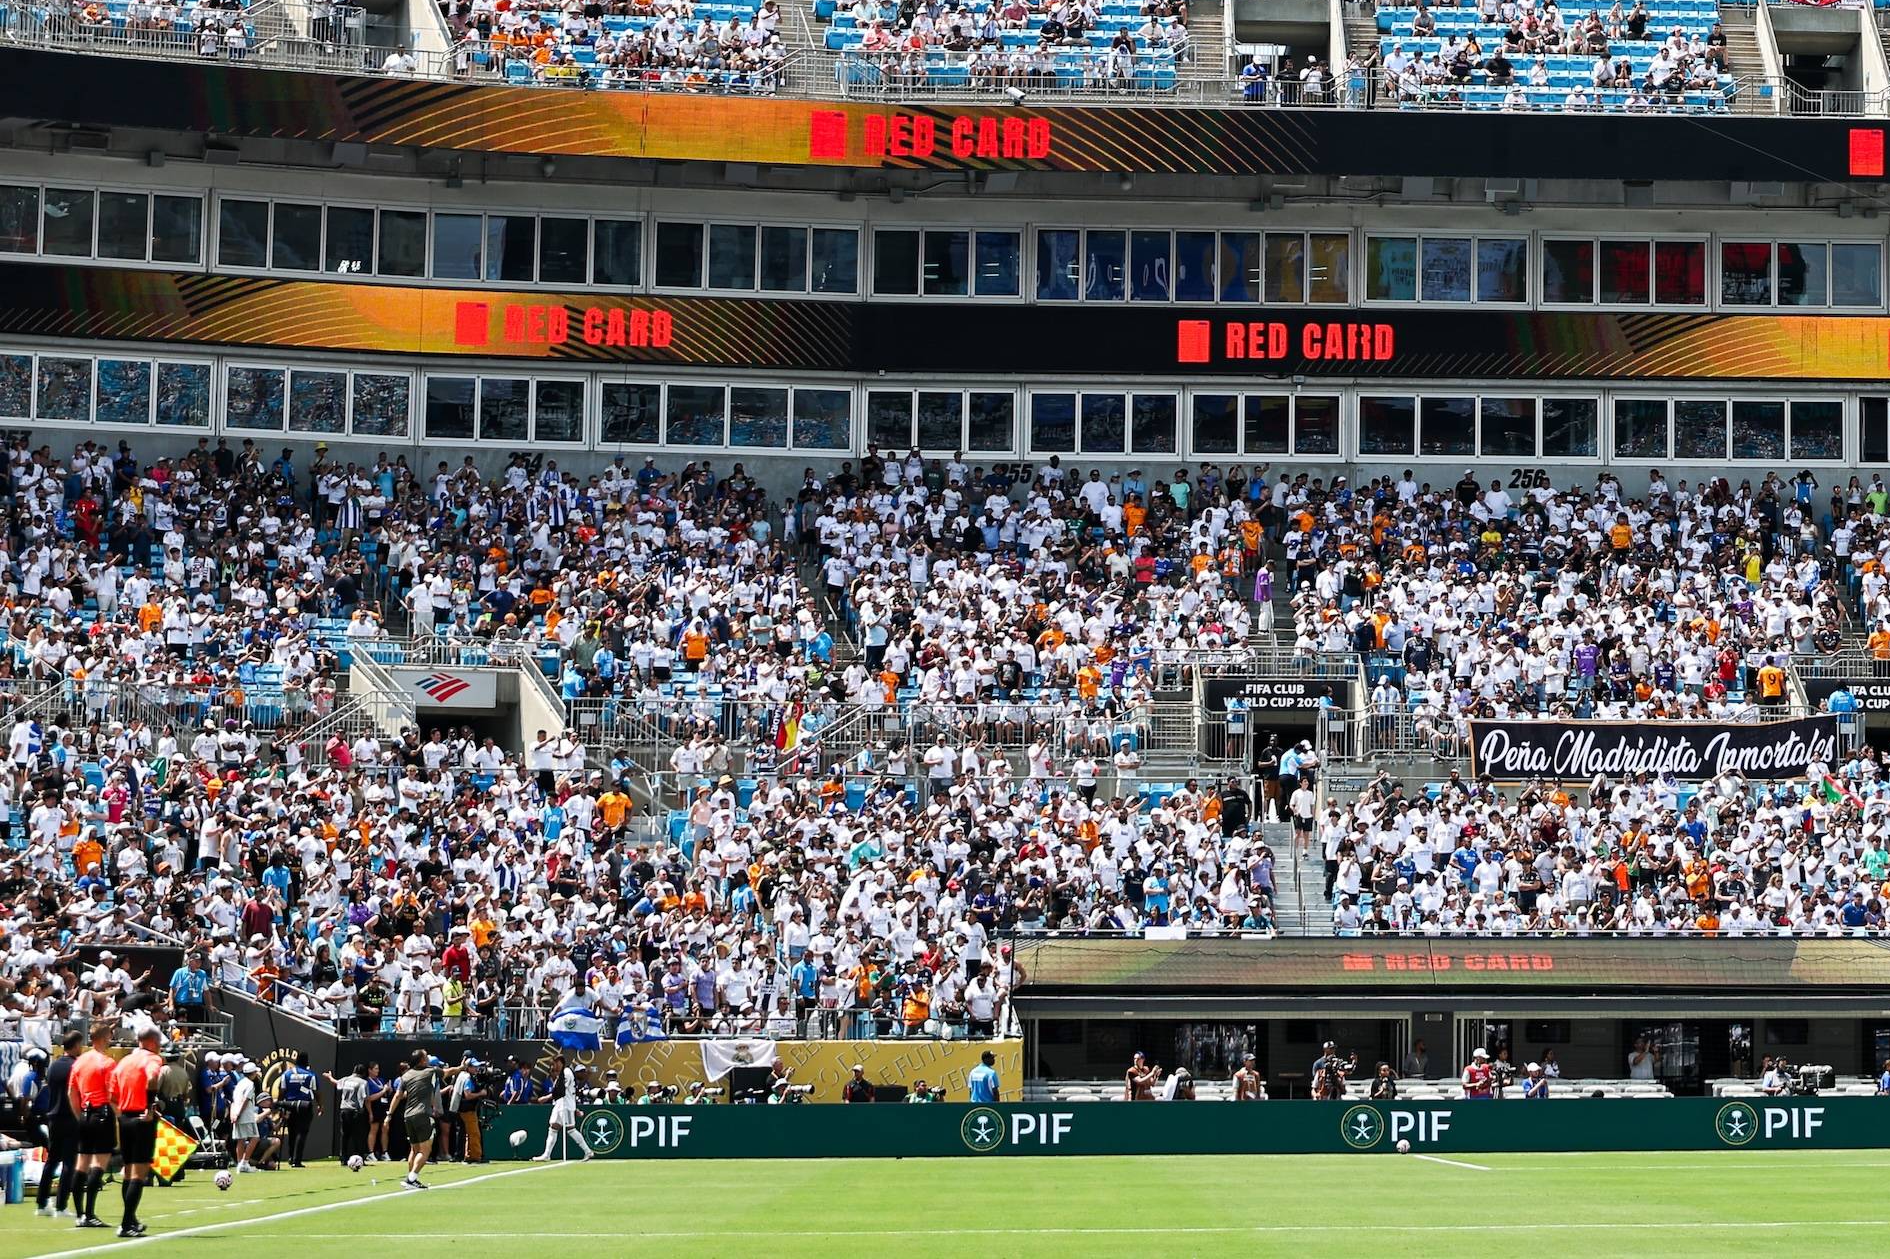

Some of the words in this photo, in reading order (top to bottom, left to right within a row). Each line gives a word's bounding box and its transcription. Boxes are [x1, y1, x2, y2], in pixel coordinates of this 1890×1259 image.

[864, 113, 935, 158] RED
[952, 116, 1051, 158] CARD
[504, 304, 569, 344] RED
[583, 307, 673, 348] CARD
[1226, 322, 1288, 359] RED
[1303, 323, 1393, 360] CARD
[1008, 463, 1033, 484] 55
[1508, 468, 1546, 489] 256
[1245, 683, 1273, 695] FIFA
[1273, 683, 1305, 695] CLUB
[1768, 672, 1777, 685] 9
[1848, 685, 1867, 696] IFA
[1273, 697, 1295, 708] CUP
[1296, 697, 1320, 708] 202
[1867, 698, 1890, 710] CUP
[1480, 729, 1552, 775] Peña
[1554, 729, 1702, 777] Madridista
[1703, 727, 1835, 773] Inmortales
[1385, 954, 1451, 971] RED
[1464, 954, 1554, 971] CARD
[261, 1047, 298, 1068] WORLD
[630, 1115, 693, 1148] PIF
[1011, 1112, 1074, 1145] PIF
[1390, 1111, 1452, 1142] PIF
[1765, 1107, 1825, 1138] PIF
